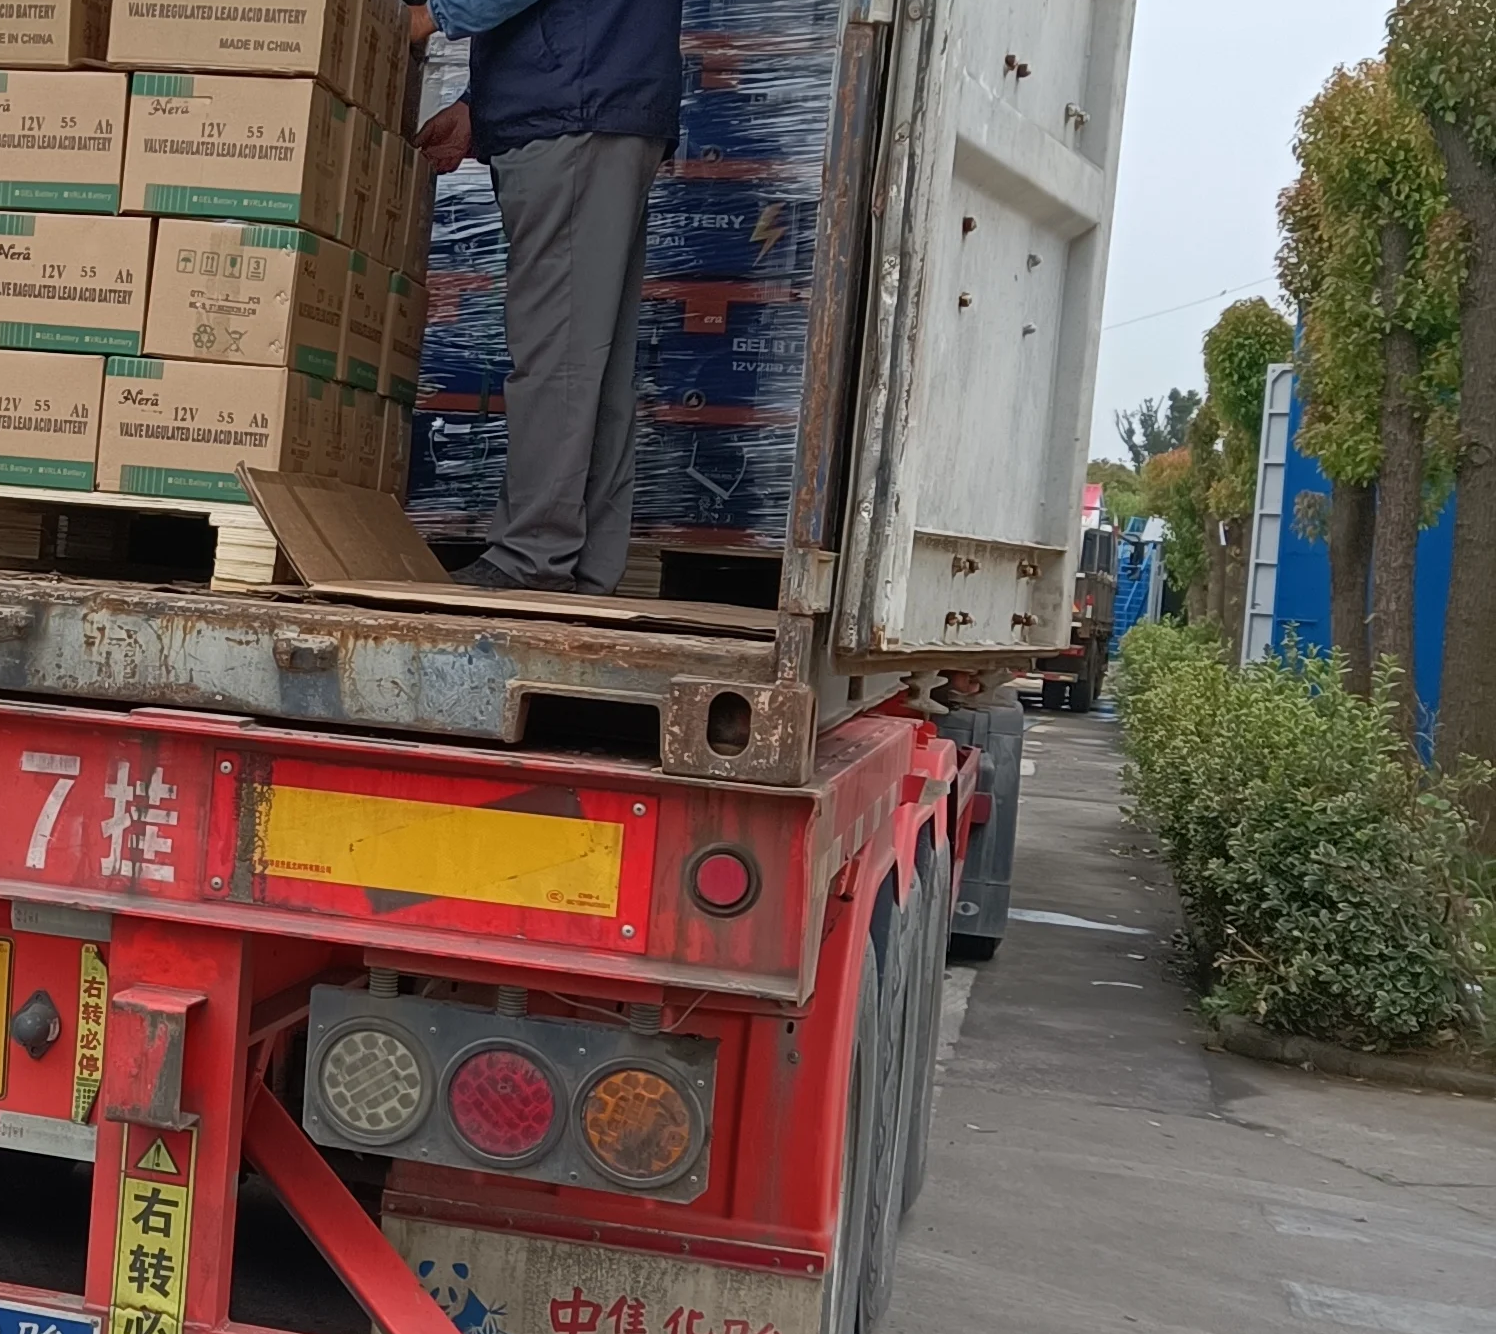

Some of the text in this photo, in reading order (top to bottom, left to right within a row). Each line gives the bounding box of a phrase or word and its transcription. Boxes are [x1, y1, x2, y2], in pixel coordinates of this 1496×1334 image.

[16, 4, 56, 19] BATTERY
[129, 2, 307, 24] VALVE REGULATED LEAD ACID BATTERY
[8, 33, 18, 44] IN
[21, 33, 53, 44] CHINA
[219, 38, 300, 52] MADE IN CHINA
[21, 116, 112, 135] 12V 55 Ah
[201, 122, 296, 144] 12V 55 Ah
[38, 135, 56, 150] LEAD
[58, 136, 76, 150] ACID
[78, 136, 112, 151] BATTERY
[144, 138, 294, 162] VALVE RAGULATED LEAD ACID BATTERY
[41, 264, 133, 284] 12V 55 Ah
[13, 282, 56, 300] RAGULATED
[58, 285, 77, 301] LEAD
[78, 286, 96, 303] ACID
[98, 287, 133, 305] BATTERY
[34, 400, 50, 411] 55
[70, 403, 88, 418] Ah
[173, 407, 268, 429] 12V 55 Ah
[13, 415, 32, 431] LEAD
[33, 416, 52, 433] ACID
[53, 417, 88, 435] BATTERY
[120, 422, 269, 448] VALVE RAGULATED LEAD ACID BATTERY
[78, 976, 105, 1077] 右转必停
